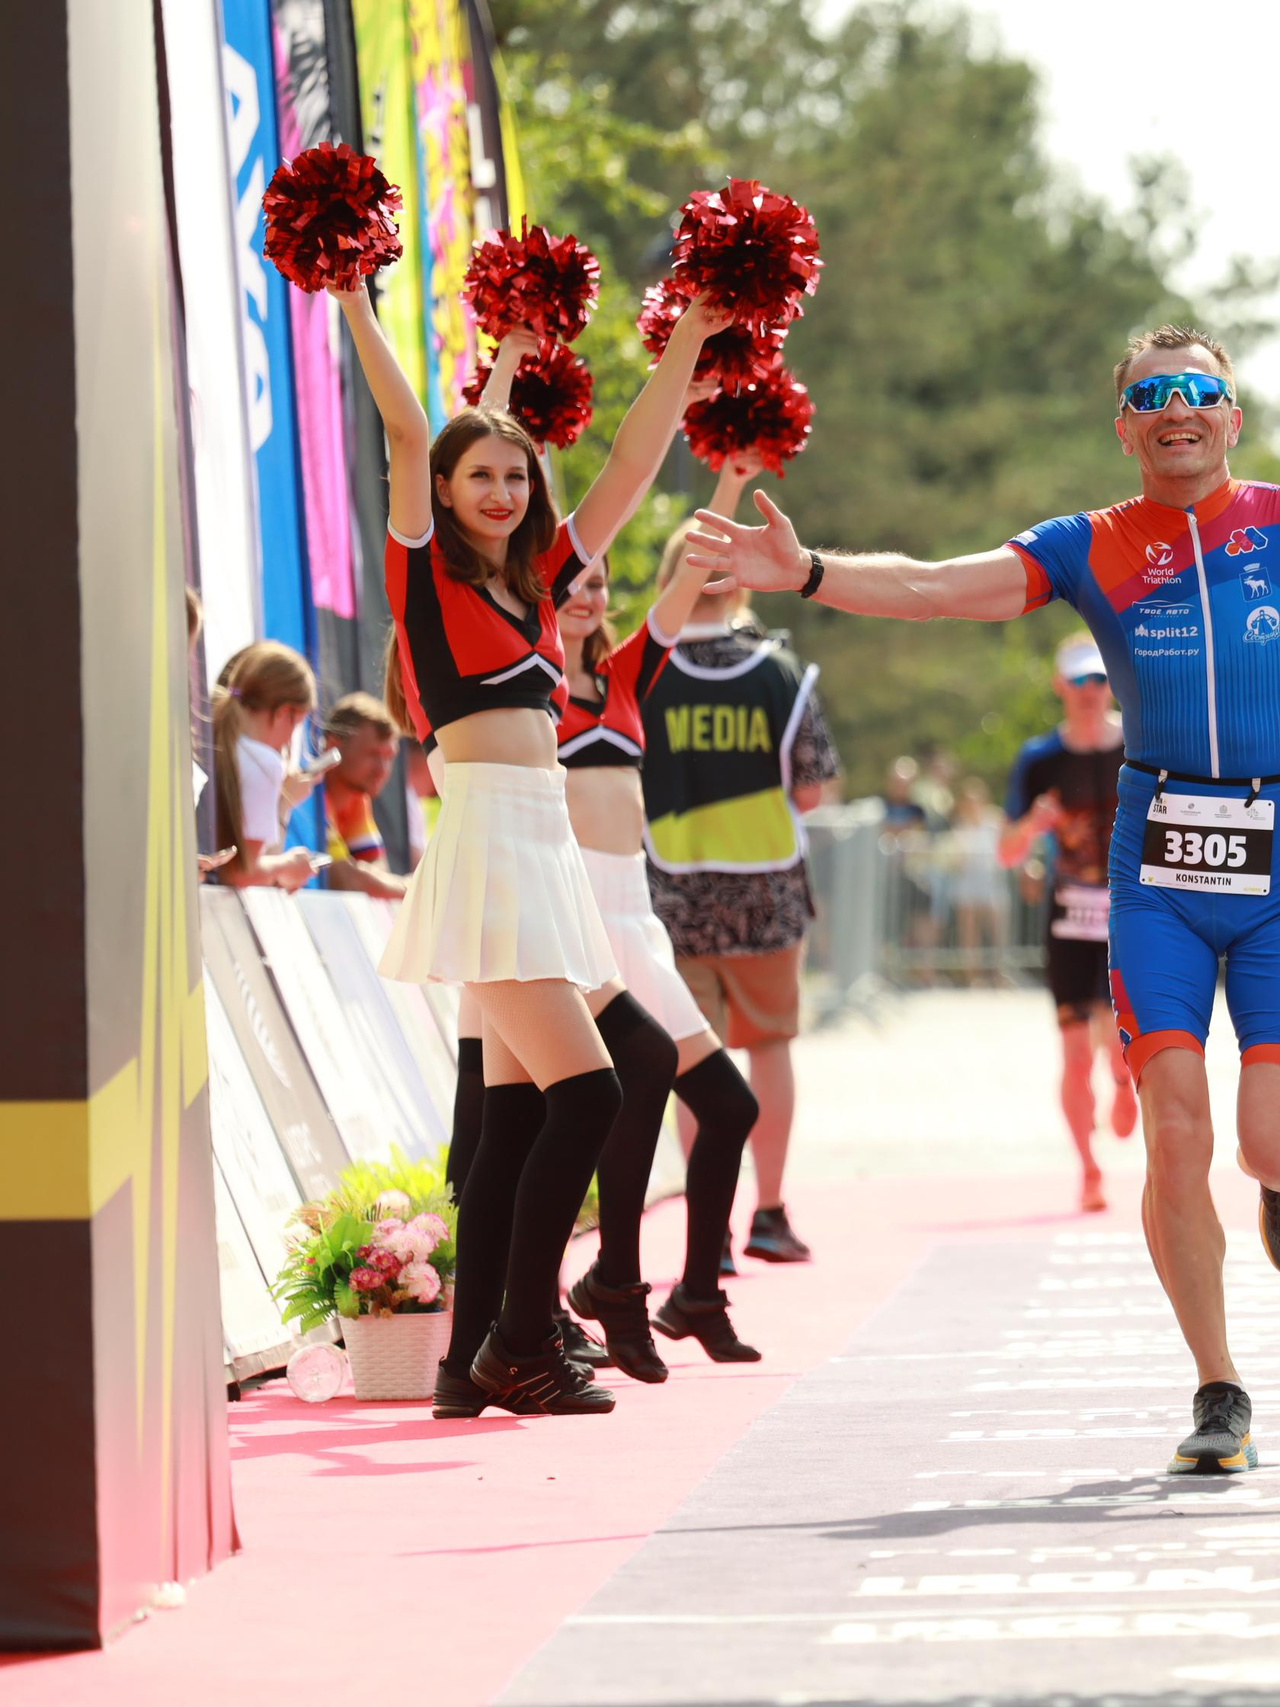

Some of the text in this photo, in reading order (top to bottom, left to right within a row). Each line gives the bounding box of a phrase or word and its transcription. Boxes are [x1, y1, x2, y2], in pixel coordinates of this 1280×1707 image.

[1147, 567, 1174, 576] World
[1142, 575, 1182, 584] Triathlon
[1150, 626, 1198, 640] split12
[664, 704, 773, 753] MEDIA
[1153, 803, 1167, 815] STAR
[1164, 830, 1247, 868] 3305
[1175, 873, 1232, 886] KONSTANTIN
